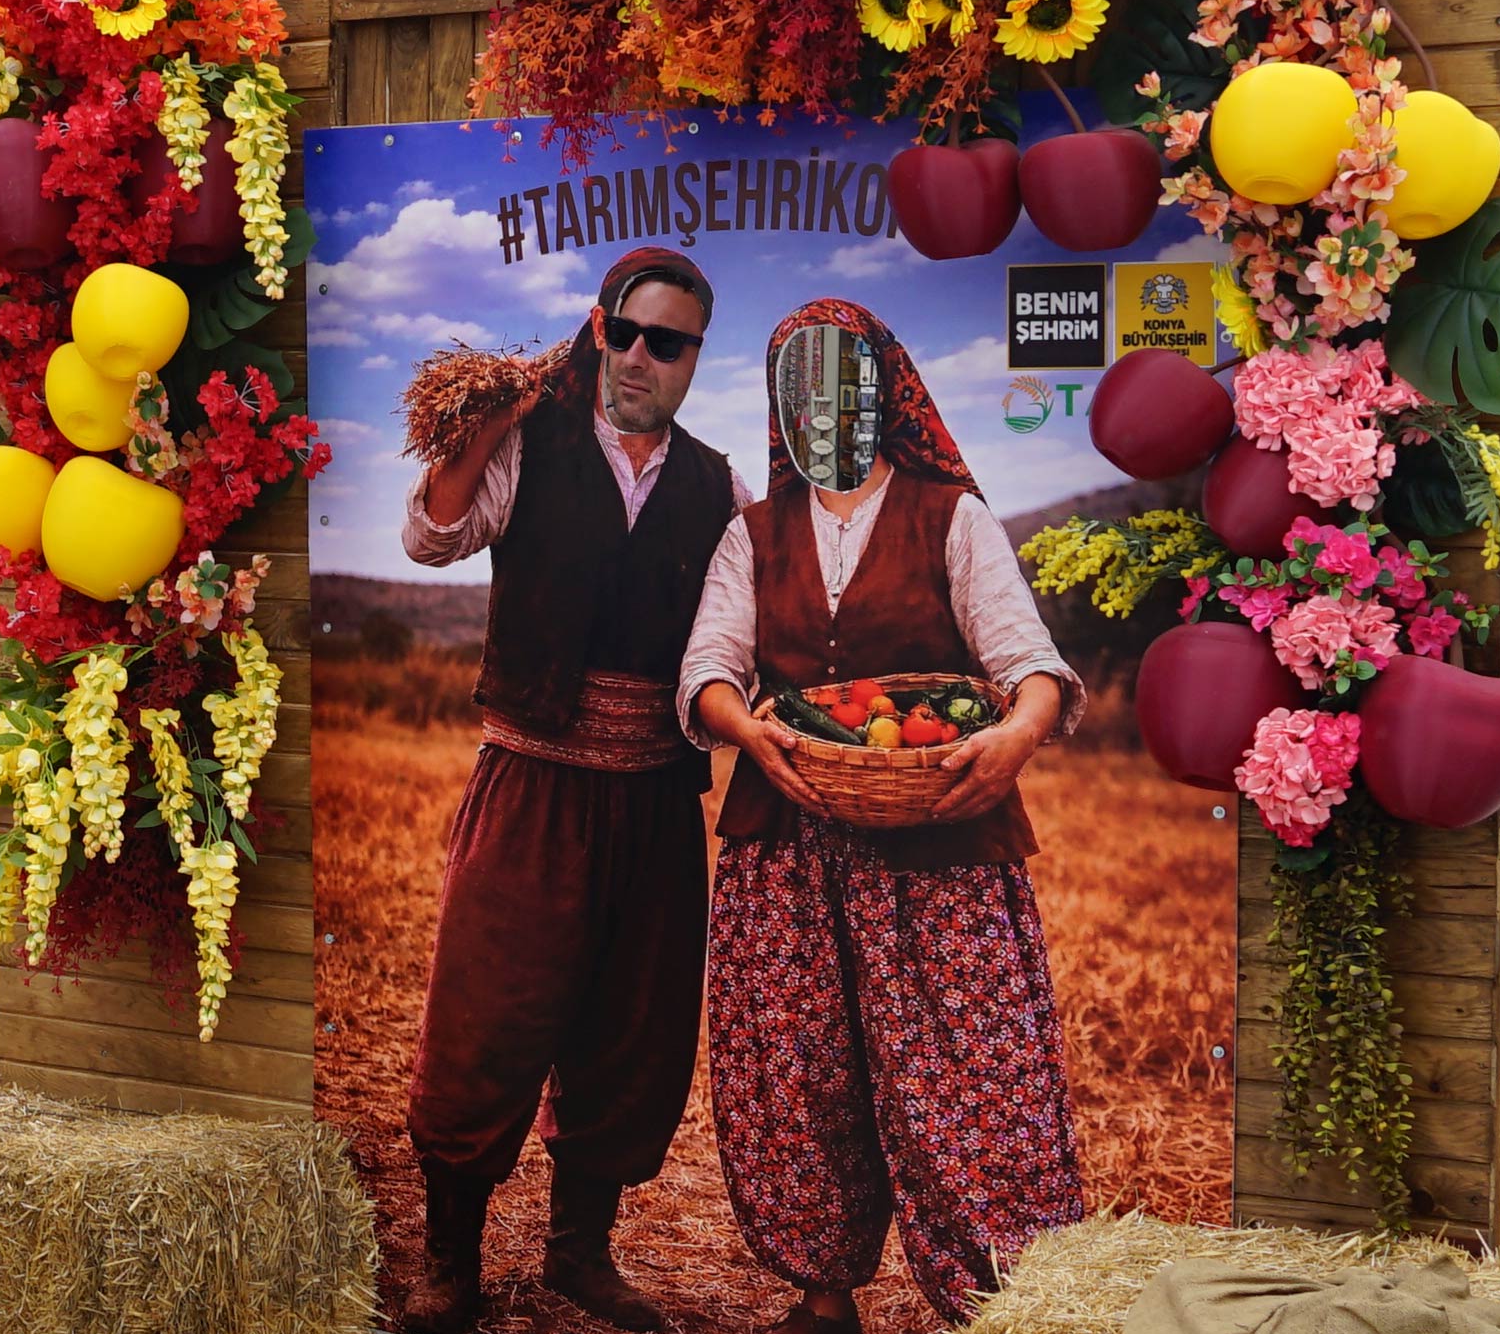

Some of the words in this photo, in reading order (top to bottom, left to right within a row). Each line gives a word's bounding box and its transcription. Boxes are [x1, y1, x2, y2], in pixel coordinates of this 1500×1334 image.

[1015, 291, 1099, 316] BENİM
[1015, 320, 1099, 345] ŞEHRİM
[1143, 319, 1186, 331] KONYA
[1122, 330, 1208, 347] BÜYÜKŞEHİR
